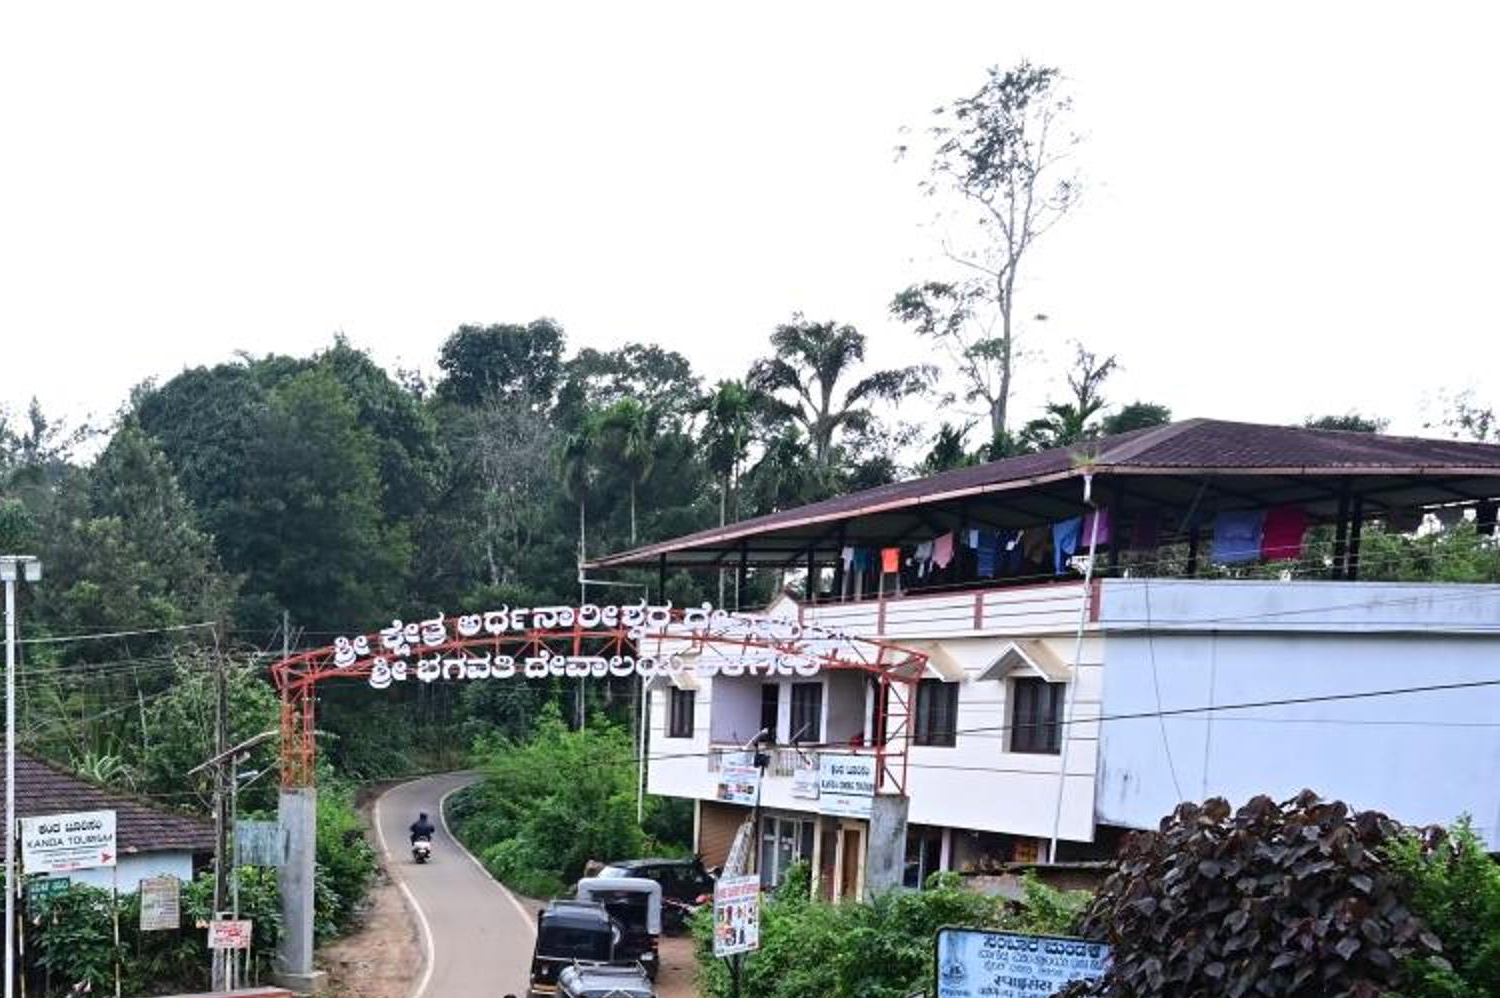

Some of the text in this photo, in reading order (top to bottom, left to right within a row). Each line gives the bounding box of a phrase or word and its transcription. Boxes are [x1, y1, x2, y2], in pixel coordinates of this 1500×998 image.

[334, 636, 370, 668] ಶ್ರೀ
[369, 656, 407, 689] ಶ್ರೀ
[417, 652, 516, 683] ಭಗವತಿ
